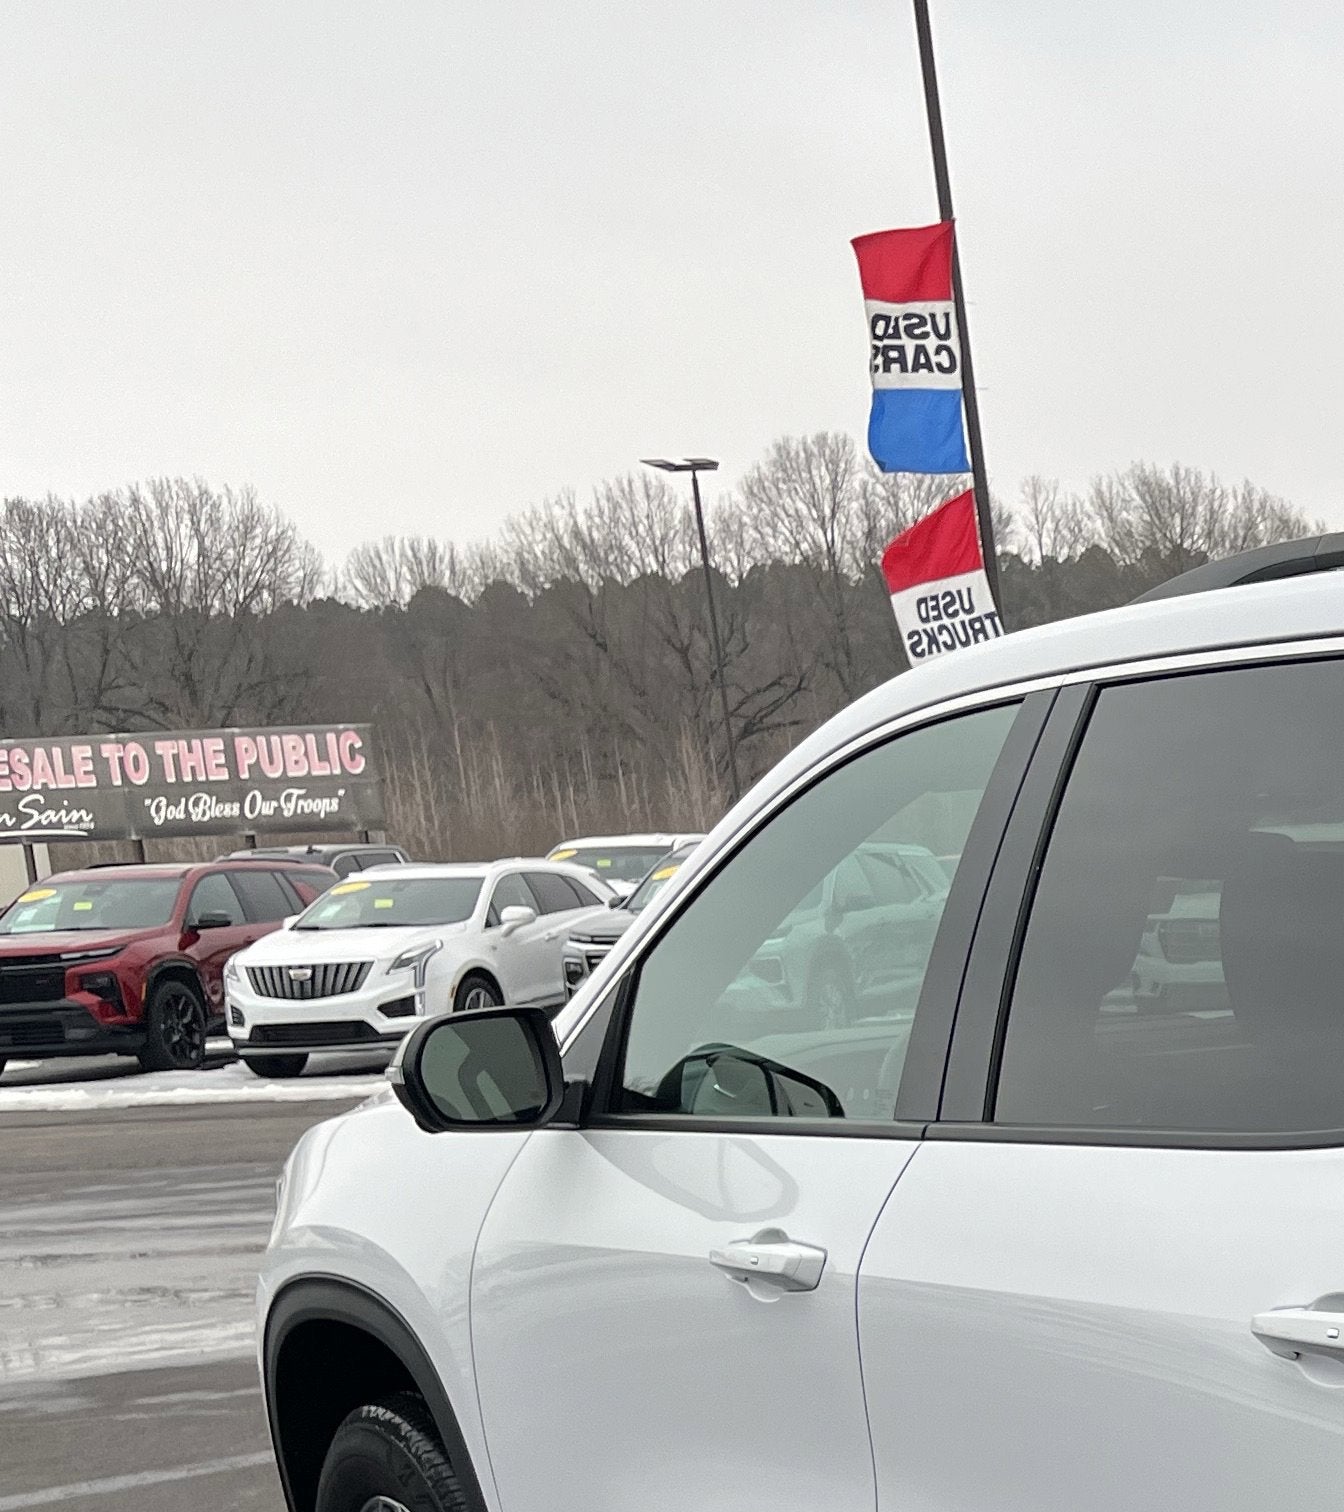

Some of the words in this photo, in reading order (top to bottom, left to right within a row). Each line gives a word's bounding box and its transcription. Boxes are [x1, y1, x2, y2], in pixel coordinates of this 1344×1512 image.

[101, 741, 149, 786] TO
[154, 737, 229, 783] THE
[234, 730, 366, 779] PUBLIC
[18, 793, 94, 829] Sain
[188, 792, 240, 822] Bless
[244, 789, 279, 819] Our
